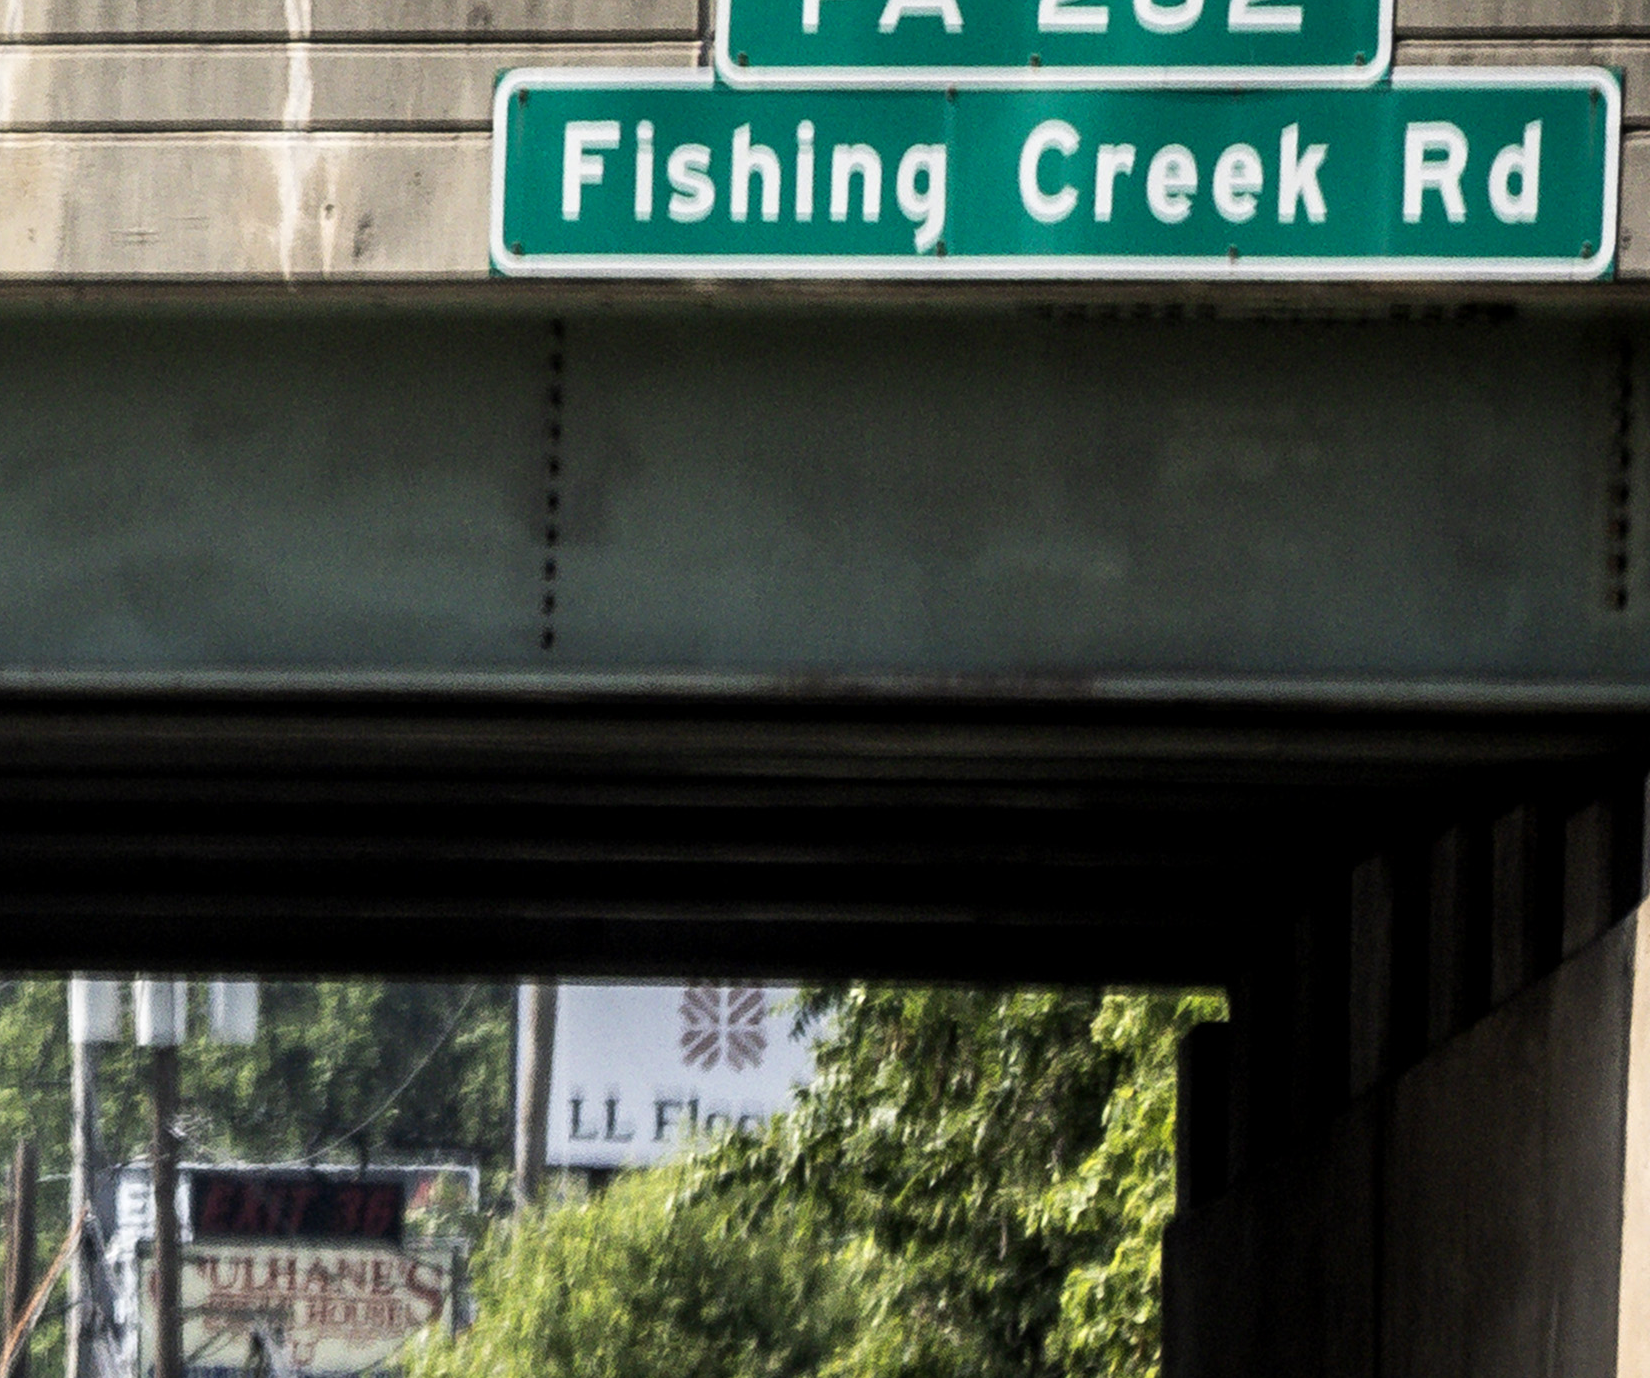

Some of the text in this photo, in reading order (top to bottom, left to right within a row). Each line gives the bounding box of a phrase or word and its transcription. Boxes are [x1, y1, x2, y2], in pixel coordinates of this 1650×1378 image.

[561, 118, 1543, 254] Fishing Creek Rd
[568, 1095, 635, 1143] LL
[150, 1257, 446, 1319] ULHANE'S
